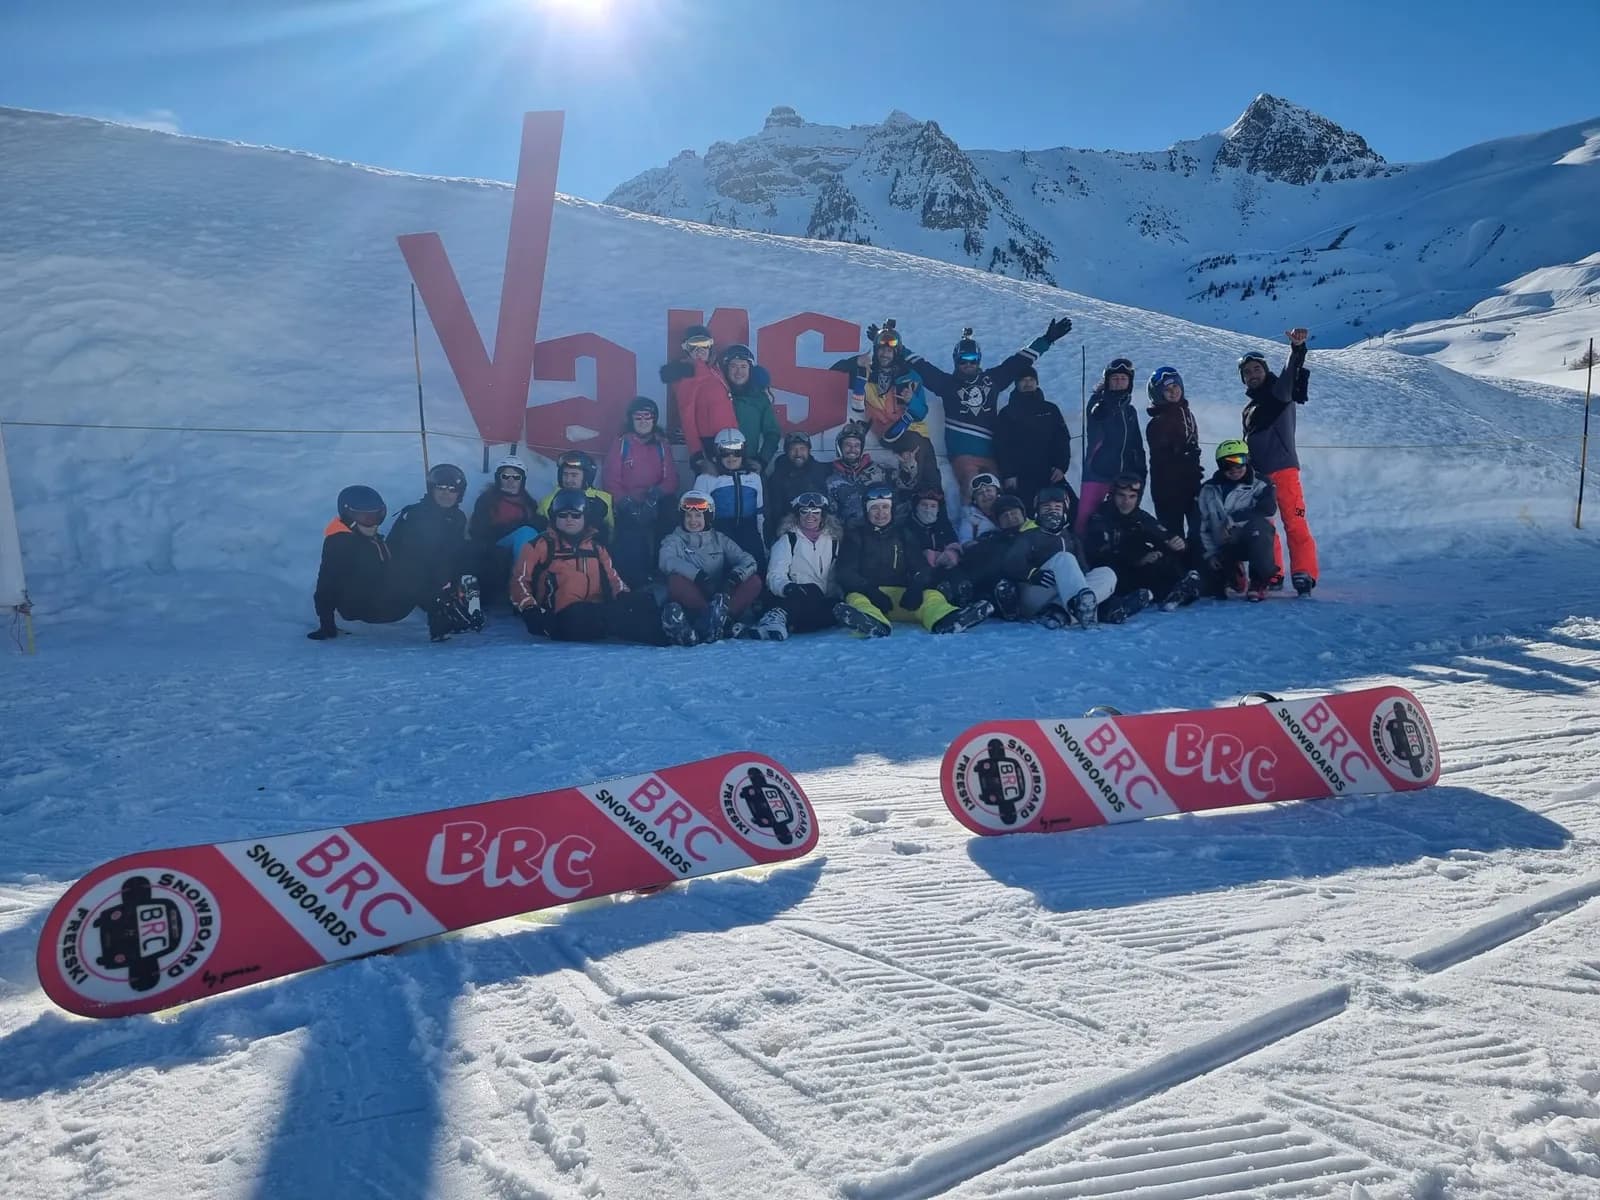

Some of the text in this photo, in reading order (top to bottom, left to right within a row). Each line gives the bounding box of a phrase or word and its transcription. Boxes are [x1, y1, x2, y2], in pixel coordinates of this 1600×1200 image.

[1054, 723, 1126, 813] SNOWBOARDS
[1084, 722, 1159, 810] BRC
[1165, 723, 1278, 800] BRC
[1278, 707, 1346, 793] SNOWBOARDS
[1301, 702, 1370, 784] BRC
[1372, 714, 1392, 765] FREESKI
[1405, 724, 1421, 753] BRC
[1407, 703, 1434, 773] SNOWBOARD
[723, 783, 751, 836] FREESKI
[765, 789, 787, 819] BRC
[766, 768, 807, 840] SNOWBOARD
[956, 754, 976, 811] FREESKI
[1000, 762, 1018, 797] BRC
[1007, 739, 1042, 819] SNOWBOARD
[595, 788, 692, 874] SNOWBOARDS
[627, 777, 724, 862] BRC
[246, 843, 358, 947] SNOWBOARDS
[296, 834, 413, 937] BRC
[425, 820, 597, 899] BRC
[62, 907, 90, 985] FREESKI
[141, 907, 168, 951] BRC
[158, 873, 213, 978] SNOWBOARD
